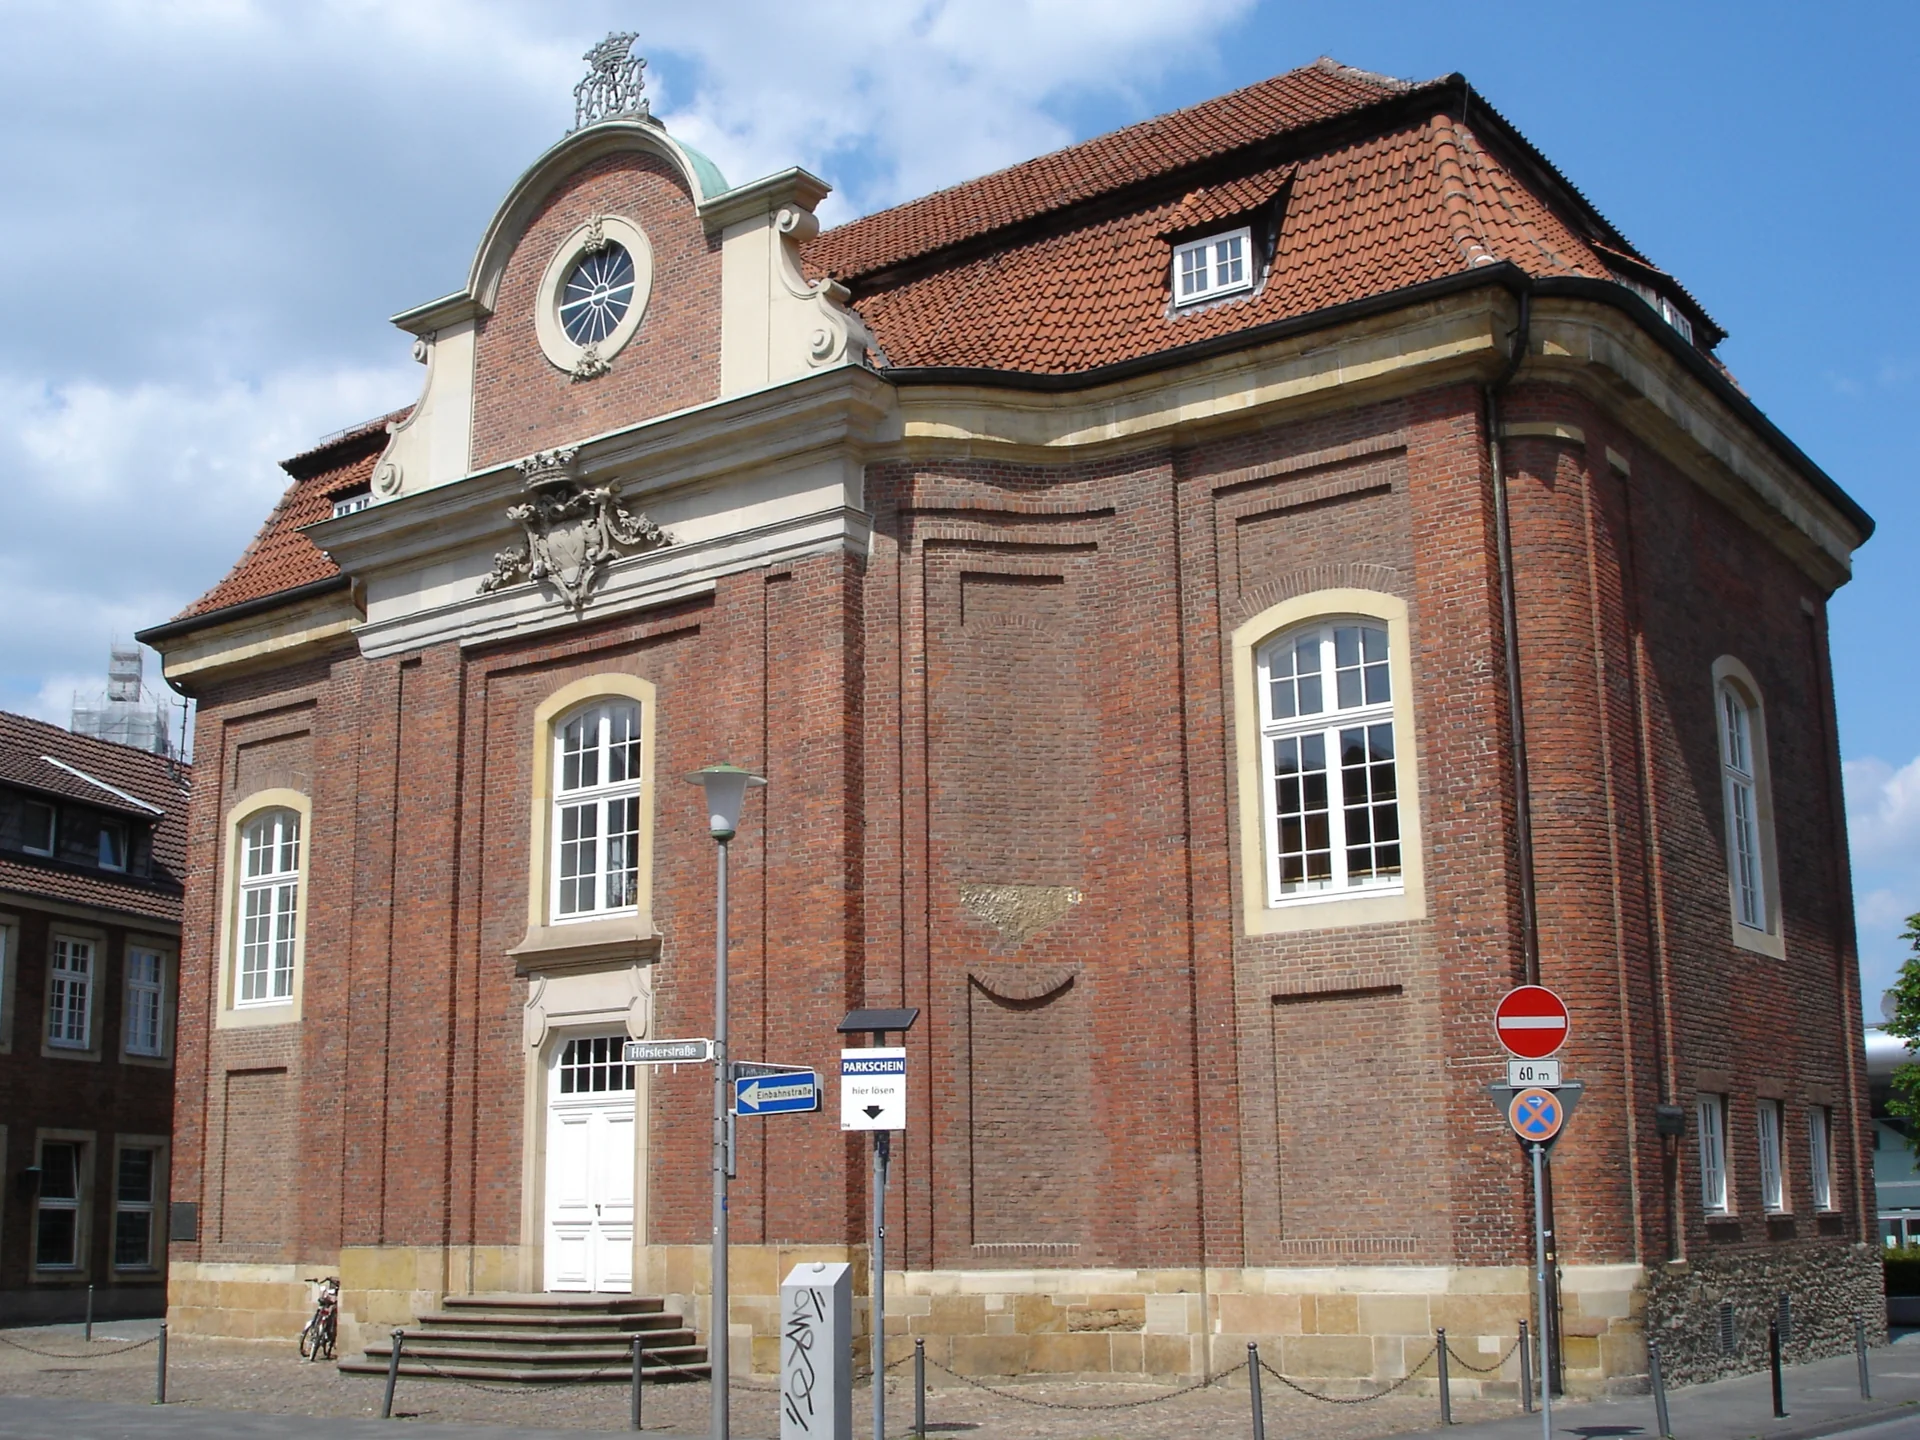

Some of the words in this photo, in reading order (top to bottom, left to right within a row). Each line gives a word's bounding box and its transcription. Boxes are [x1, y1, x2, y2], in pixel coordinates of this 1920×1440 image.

[631, 1045, 696, 1058] Hörsterstraße
[843, 1060, 904, 1072] PARKSCHEIN
[1519, 1066, 1533, 1080] 60
[1538, 1072, 1549, 1080] m
[757, 1086, 812, 1100] Einbahnstraße
[852, 1086, 869, 1095] hier
[871, 1086, 895, 1095] lösen
